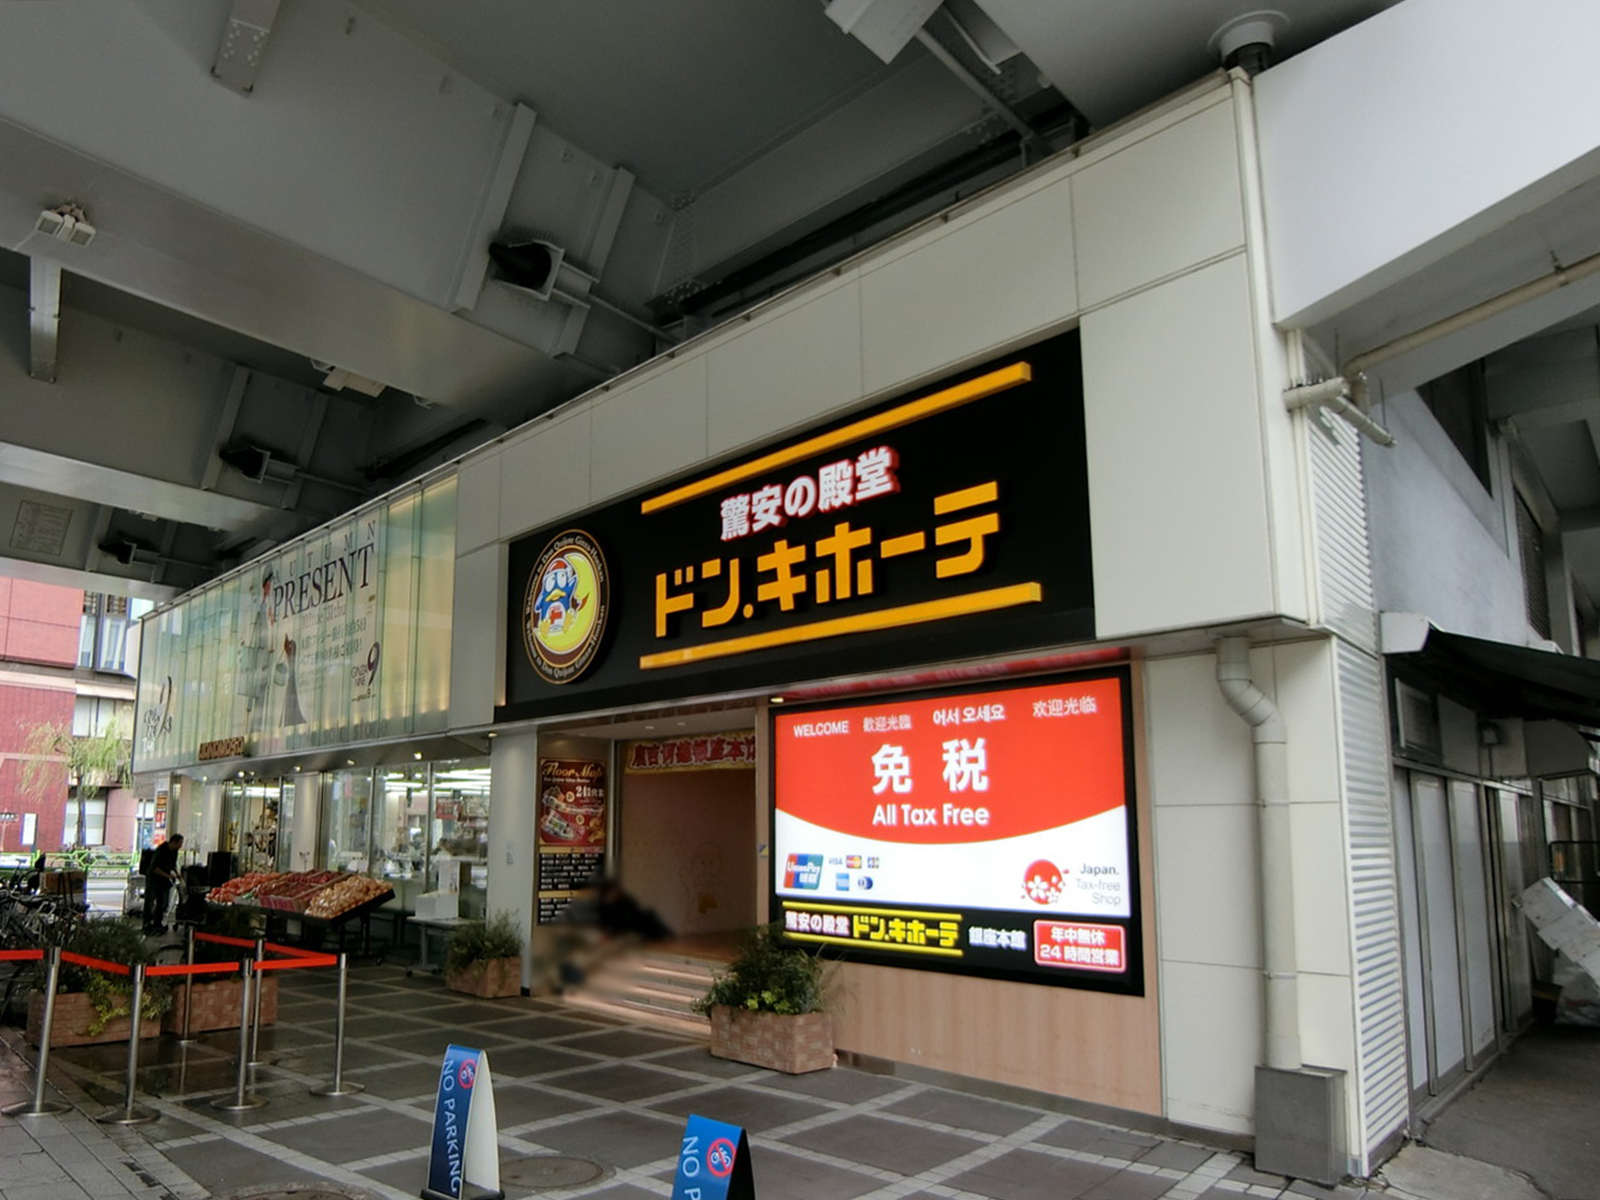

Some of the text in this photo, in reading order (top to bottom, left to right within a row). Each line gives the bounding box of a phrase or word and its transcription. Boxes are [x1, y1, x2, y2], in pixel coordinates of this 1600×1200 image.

[720, 446, 898, 540] 驚安の殿堂
[273, 542, 375, 620] PRESENT
[933, 704, 1005, 726] 어서 오세요
[1032, 695, 1098, 718] 欢迎光临
[793, 720, 849, 737] WELCOME
[872, 802, 990, 826] All Tax Free
[1079, 863, 1120, 877] Japan.
[1076, 878, 1121, 892] Tax-free
[1092, 891, 1122, 907] Shop
[1050, 926, 1106, 946] 年中無休
[442, 1059, 462, 1193] NO PARKING
[682, 1135, 700, 1178] NO
